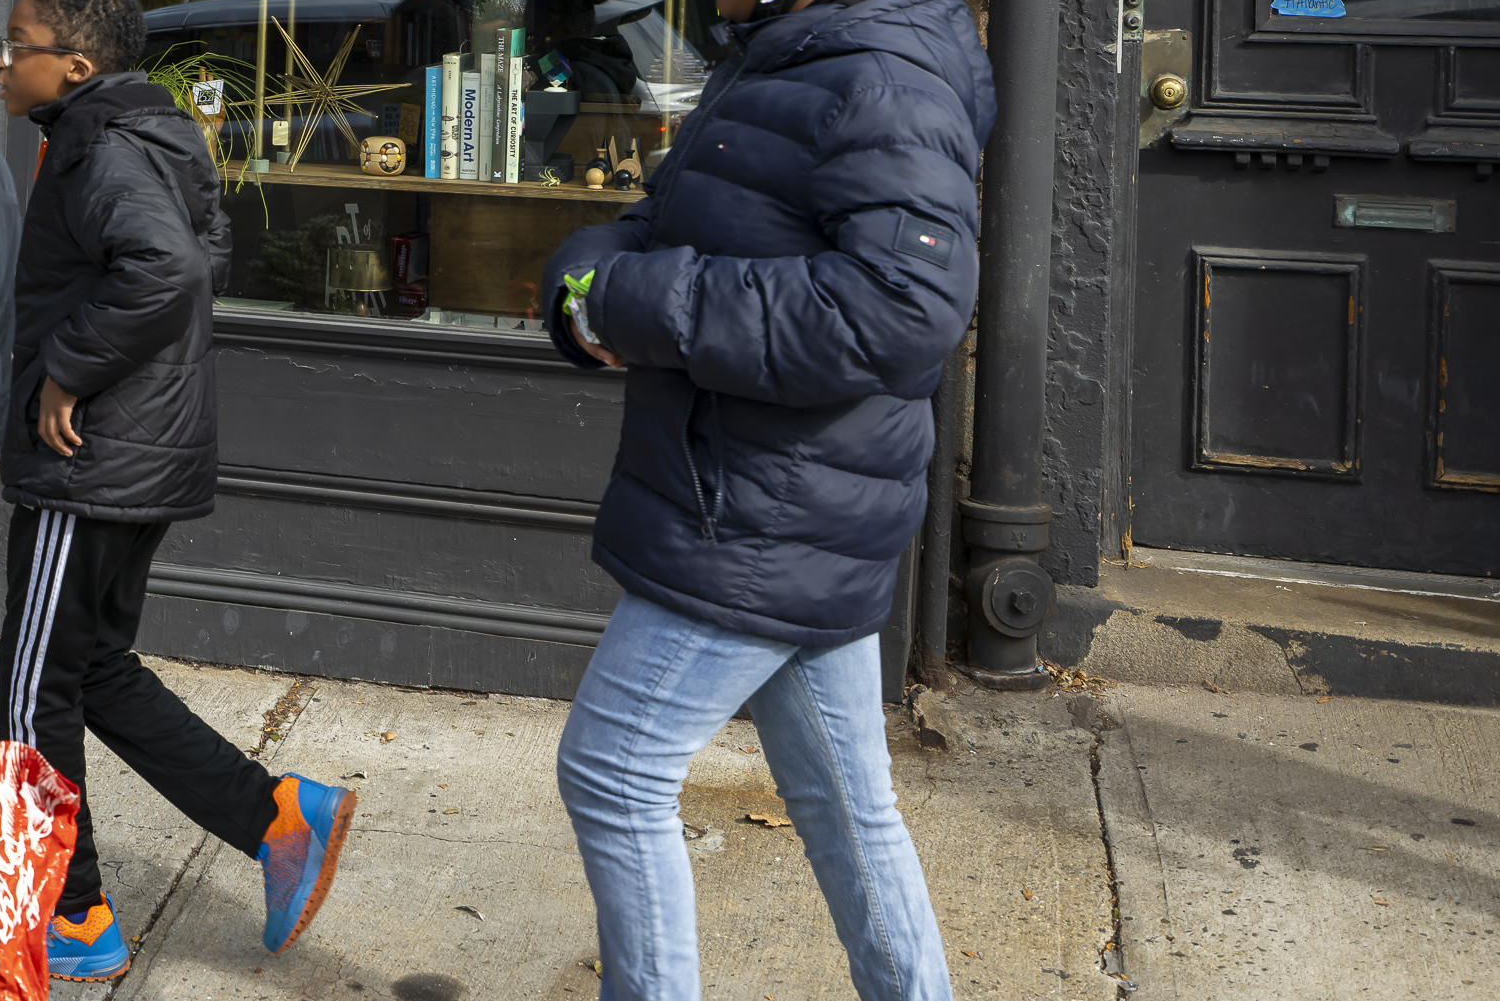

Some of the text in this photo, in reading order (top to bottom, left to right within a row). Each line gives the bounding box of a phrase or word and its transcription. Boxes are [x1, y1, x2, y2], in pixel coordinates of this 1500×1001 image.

[464, 89, 476, 140] Modern
[510, 116, 516, 124] OF
[463, 142, 474, 163] Art
